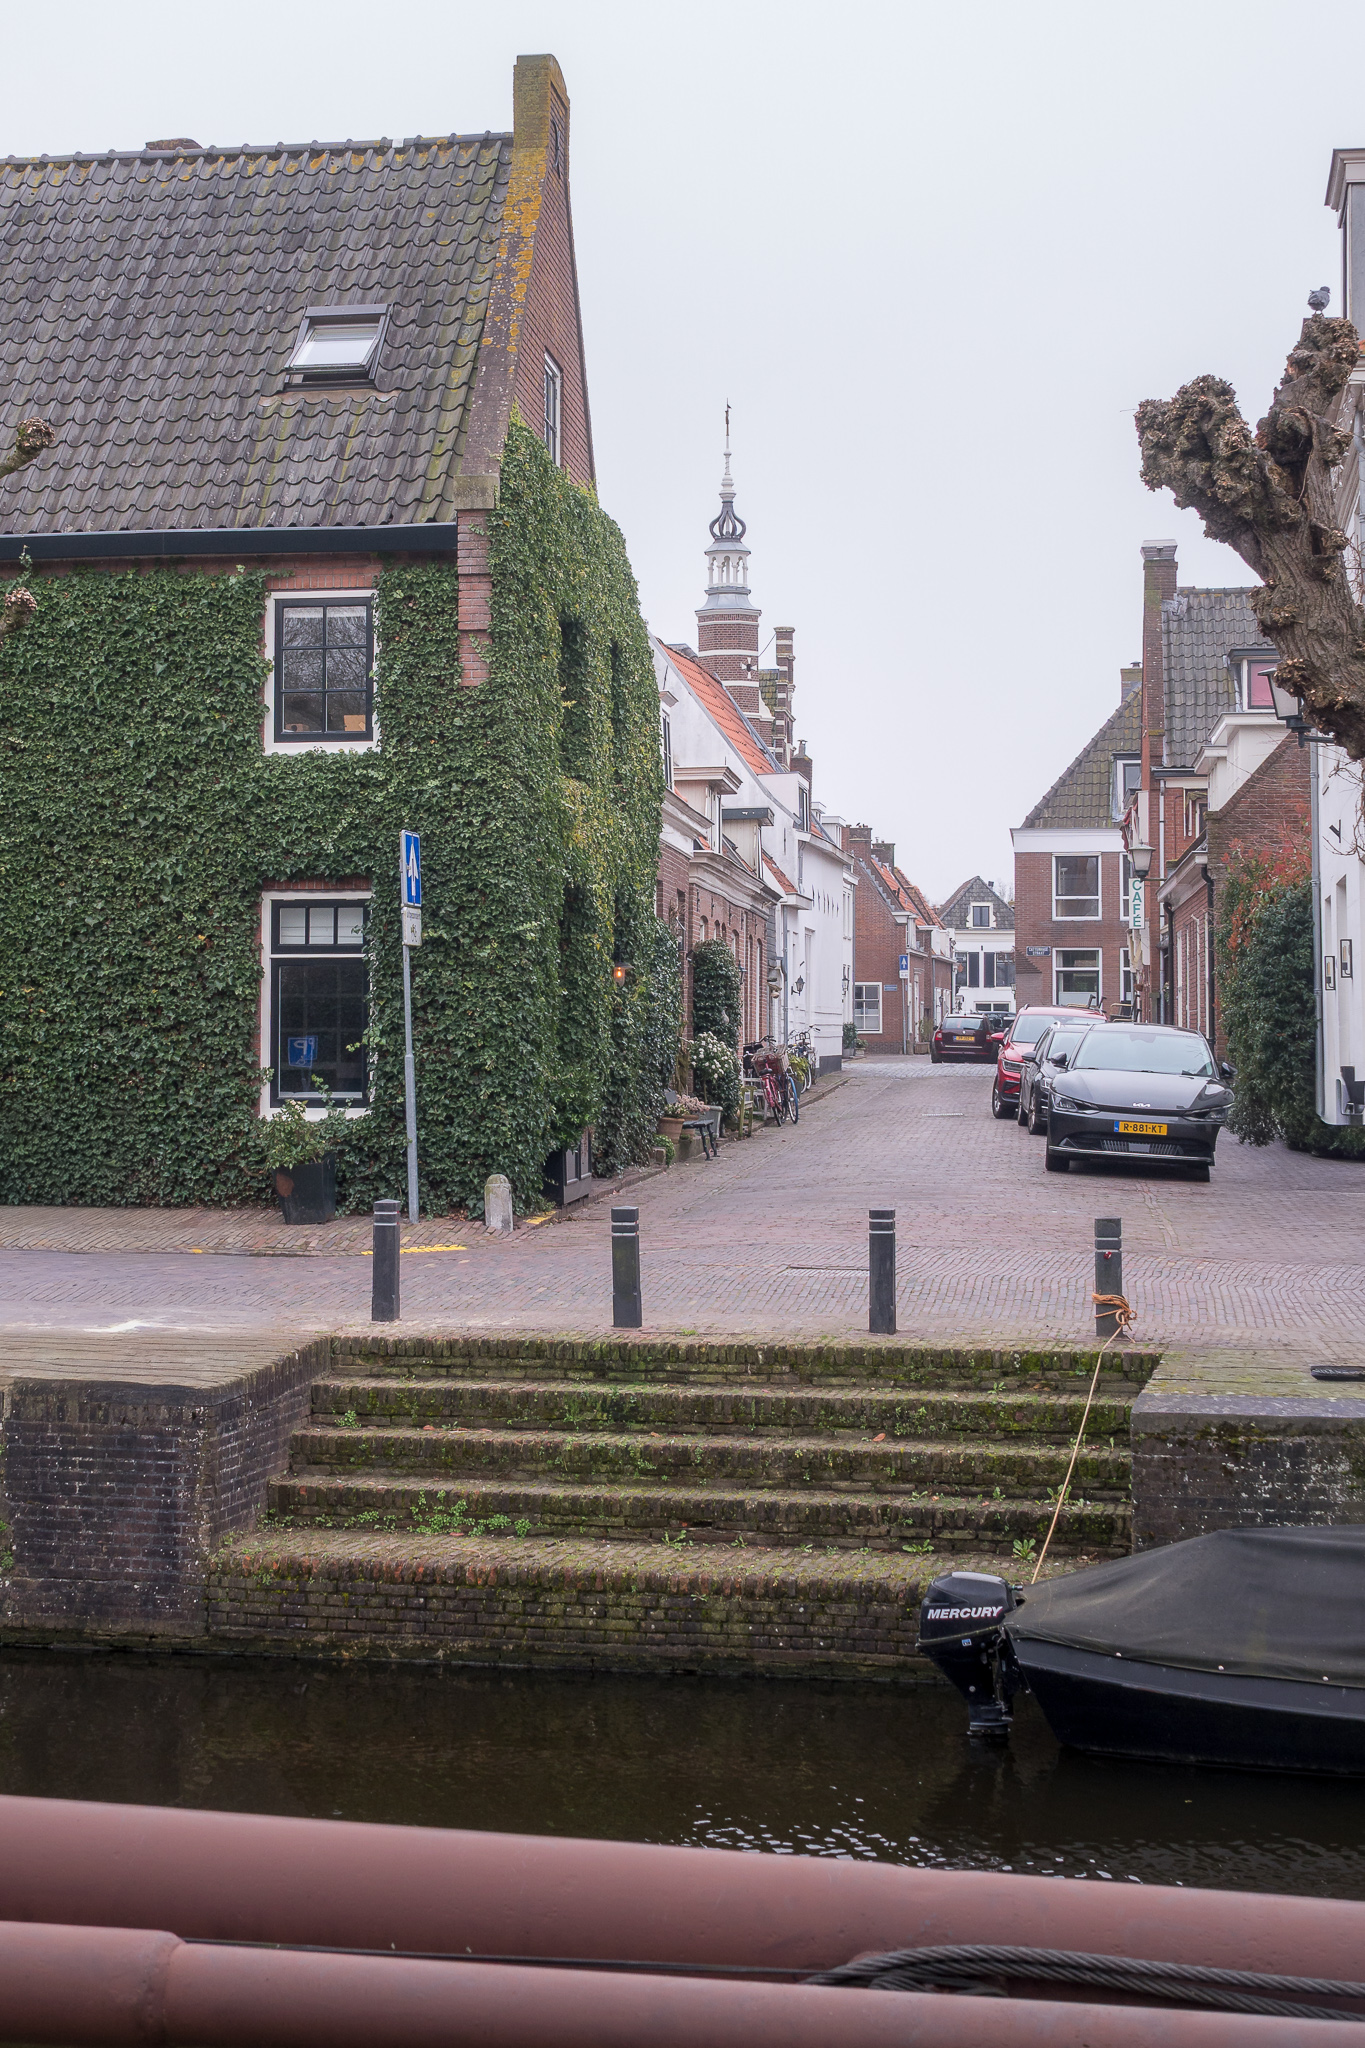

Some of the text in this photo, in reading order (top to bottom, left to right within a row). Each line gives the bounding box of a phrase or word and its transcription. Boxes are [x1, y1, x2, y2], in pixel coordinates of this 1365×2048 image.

[1132, 880, 1142, 927] CAFÉ
[1123, 1123, 1163, 1133] R-881-KT
[927, 1606, 1003, 1619] MERCURY
